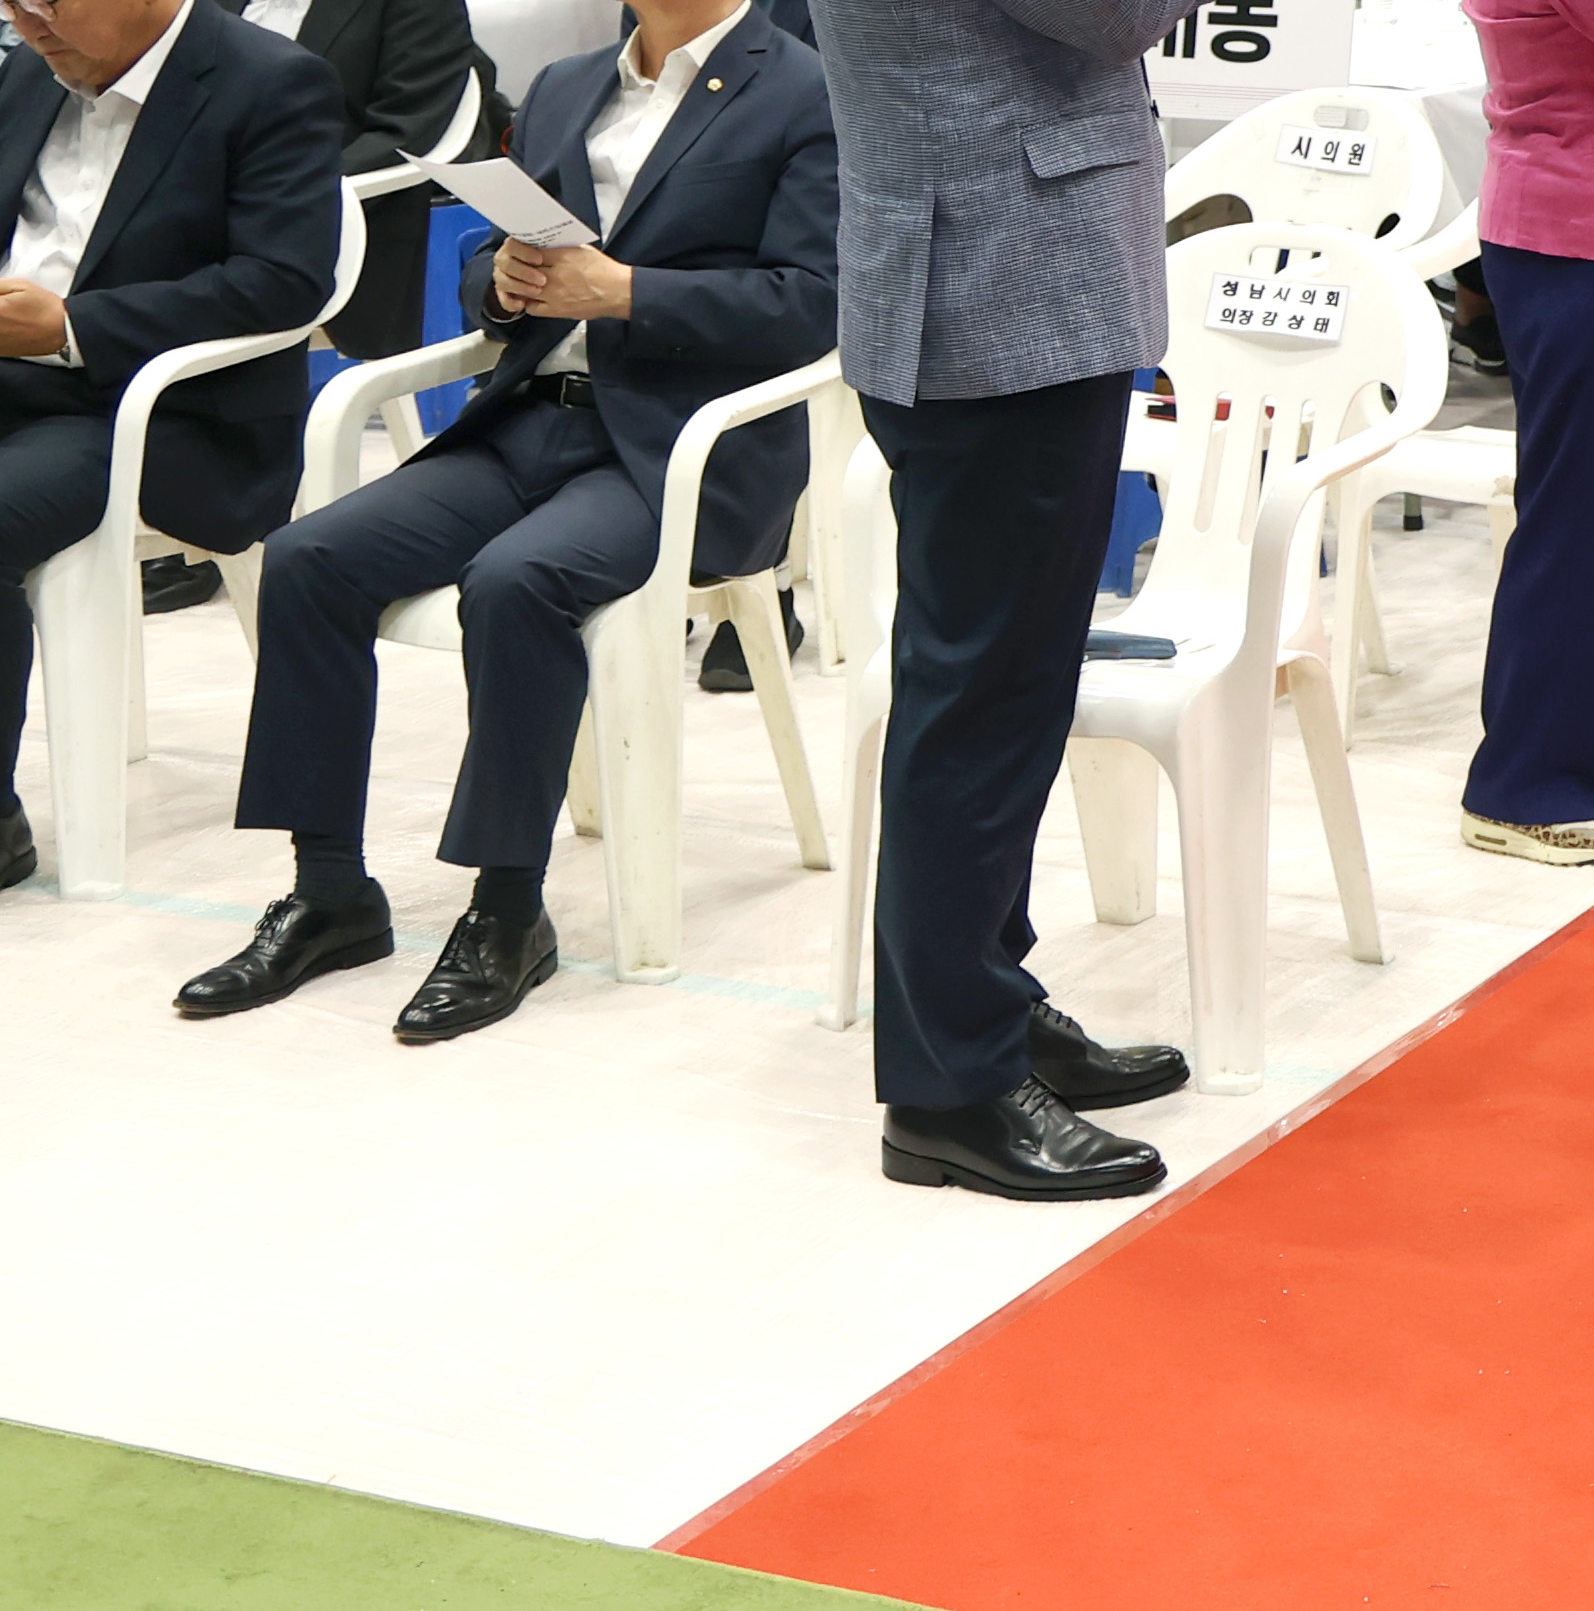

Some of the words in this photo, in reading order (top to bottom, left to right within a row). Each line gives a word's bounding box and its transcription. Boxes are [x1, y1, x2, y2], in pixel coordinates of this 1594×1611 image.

[1290, 134, 1367, 167] 시의원
[1221, 279, 1340, 308] 성남시의회
[1219, 307, 1254, 327] 의장
[1261, 308, 1330, 335] 강상태
